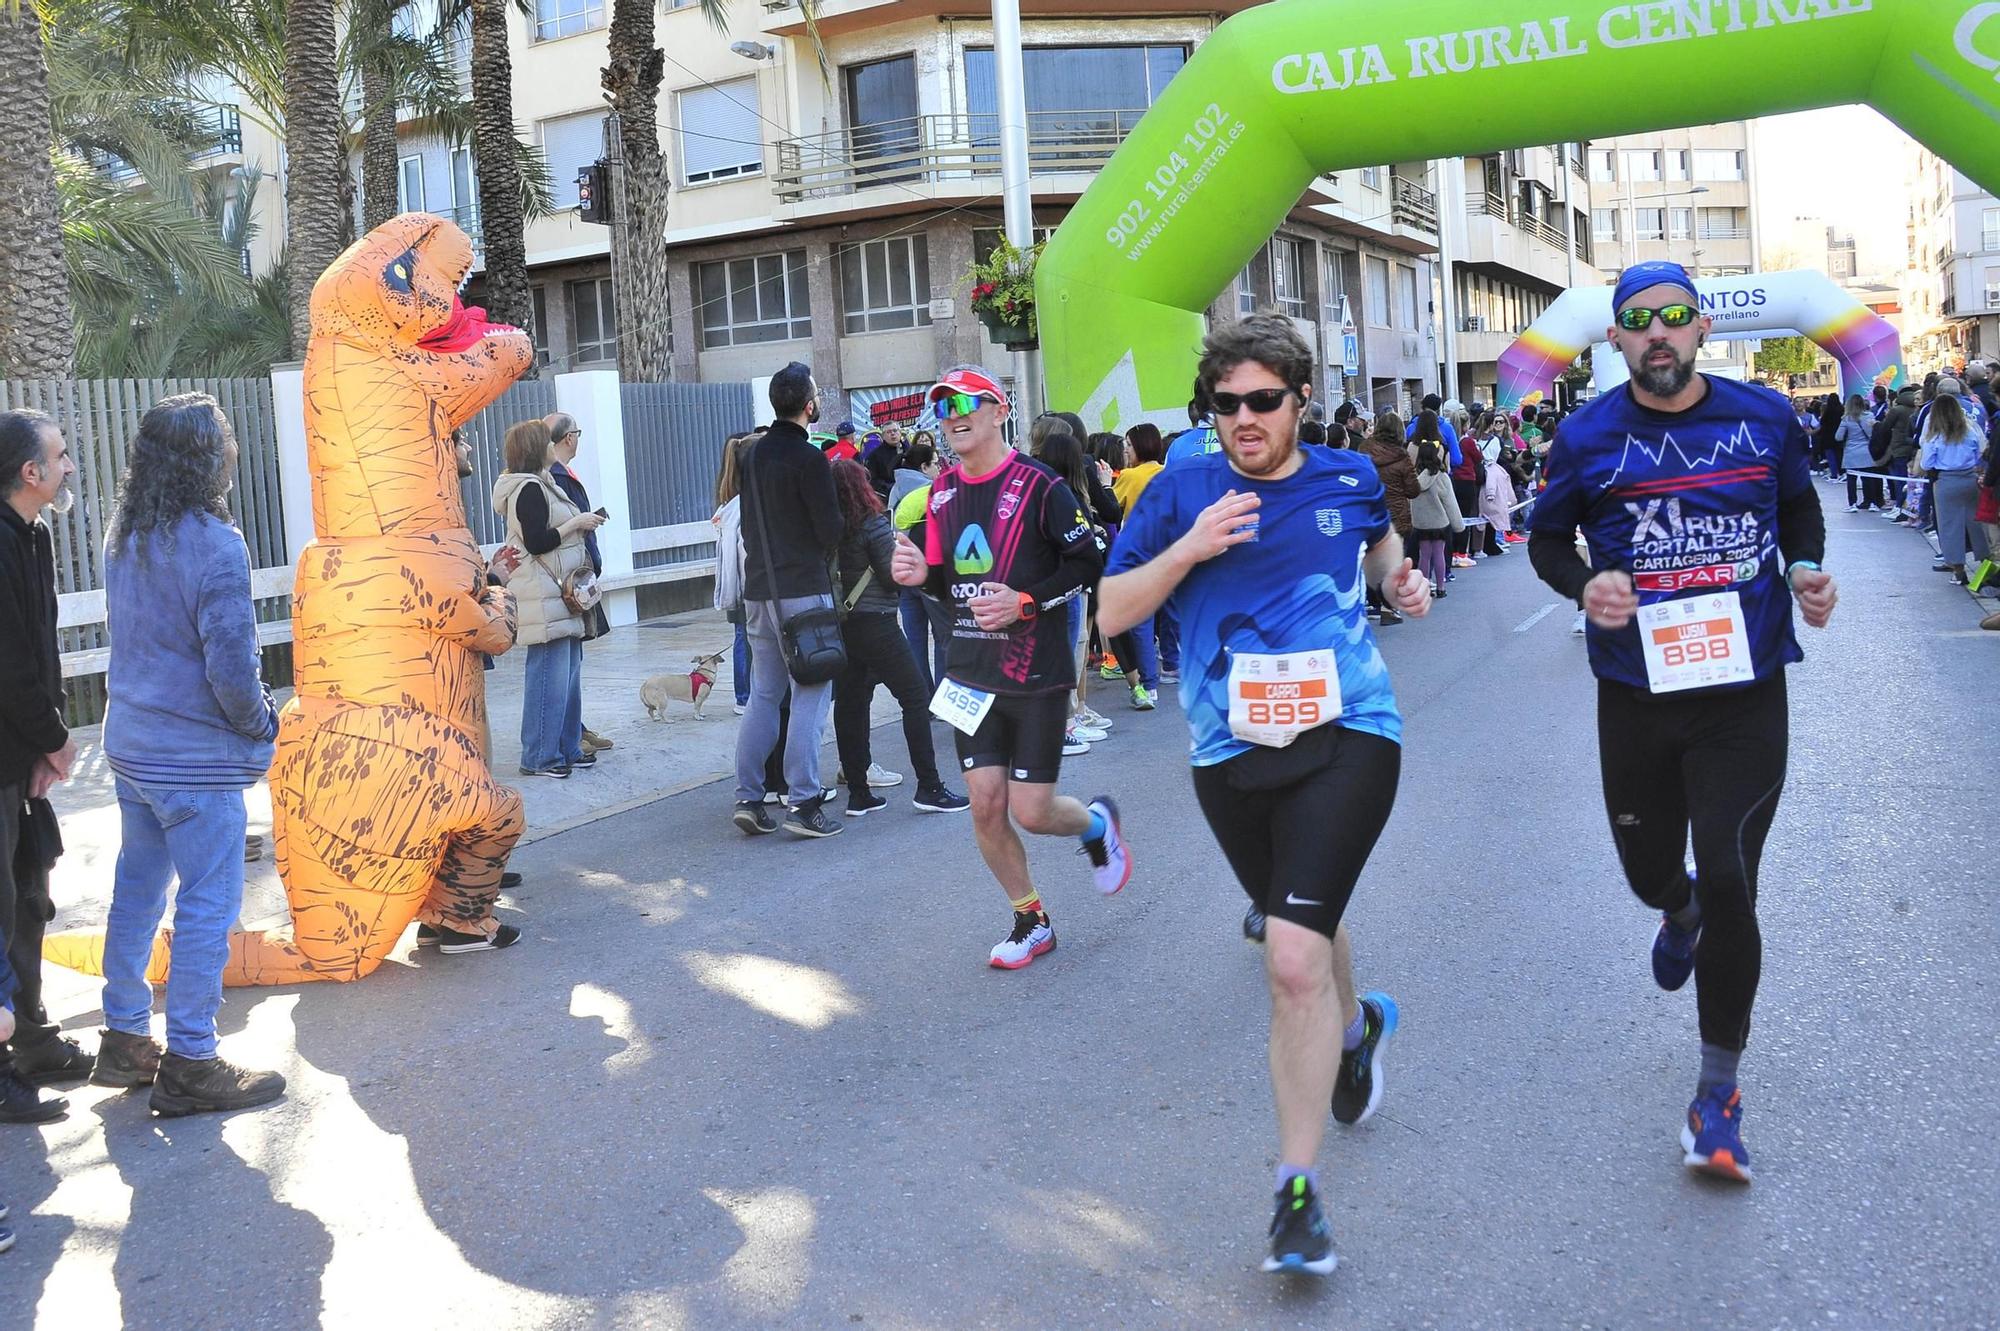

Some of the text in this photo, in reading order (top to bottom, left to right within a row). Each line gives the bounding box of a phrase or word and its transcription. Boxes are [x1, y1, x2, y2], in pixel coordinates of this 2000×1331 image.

[1271, 0, 1872, 94] CAJA RURAL CENTR
[1106, 102, 1231, 248] 902 104 102
[1126, 120, 1246, 261] www.ruralcentral.es
[1700, 288, 1767, 310] NTOS
[1700, 310, 1760, 321] orrellano
[1624, 497, 1759, 543] XI RUTA
[1633, 529, 1758, 556] FORTALEZAS
[1633, 552, 1722, 570] CARTAGENA
[1658, 567, 1732, 588] SPAR
[1663, 638, 1730, 667] 898
[943, 685, 981, 717] 1499
[1248, 702, 1319, 725] 899
